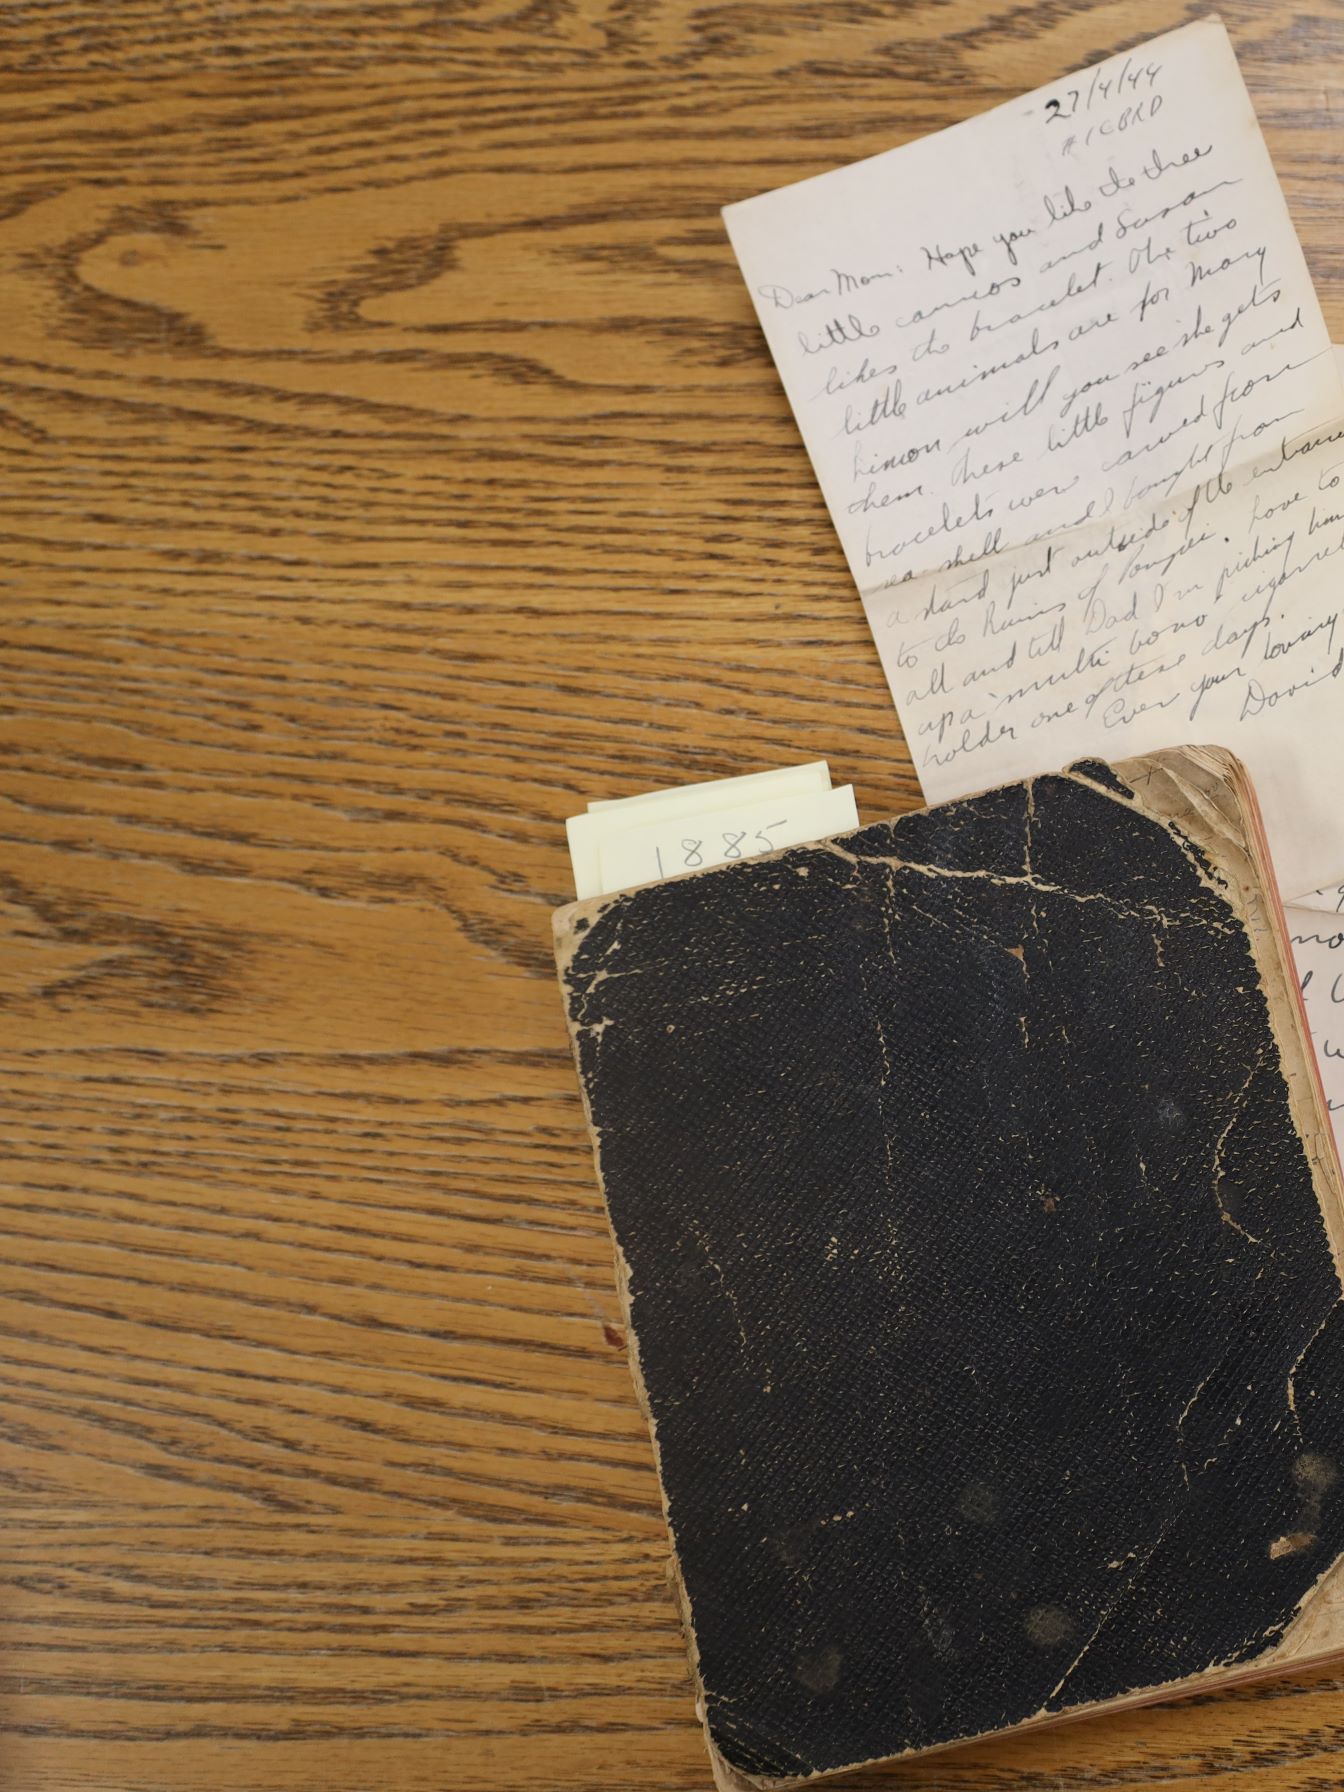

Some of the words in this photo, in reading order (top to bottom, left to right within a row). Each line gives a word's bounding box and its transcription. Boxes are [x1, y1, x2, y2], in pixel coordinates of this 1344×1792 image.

[758, 284, 830, 310] Dear
[920, 242, 984, 277] Hope
[993, 228, 1036, 266] you
[1043, 185, 1092, 225] like
[1099, 167, 1136, 197] the
[1143, 144, 1213, 180] three
[797, 314, 880, 355] little
[1040, 222, 1104, 273] and
[1116, 178, 1243, 239] Susan
[817, 358, 897, 398] likes
[912, 329, 950, 362] the
[1185, 209, 1238, 246] two
[840, 379, 907, 436] little
[916, 327, 1059, 406] animals
[1068, 312, 1119, 342] are
[1133, 280, 1170, 322] for
[955, 364, 1061, 446] will
[1060, 373, 1120, 418] you
[1124, 344, 1169, 372] see
[1174, 304, 1214, 349] she
[1218, 277, 1282, 348] gets
[1047, 402, 1108, 452] little
[1122, 359, 1225, 439] figures
[1241, 307, 1304, 355] and
[866, 492, 999, 567] bracelets
[1025, 500, 1095, 546] and
[1124, 437, 1228, 510] bought
[1219, 409, 1304, 474] from
[887, 605, 909, 628] a
[915, 568, 990, 621] stand
[1008, 546, 1063, 608] just
[1071, 512, 1170, 568] outside
[897, 639, 928, 669] to
[982, 600, 1067, 637] Ruins
[1077, 562, 1110, 622] of
[1317, 461, 1344, 491] to
[906, 662, 953, 705] all
[962, 641, 1017, 688] and
[1028, 615, 1066, 660] tell
[1085, 591, 1138, 636] Dad
[1214, 531, 1295, 604] picking
[918, 710, 955, 744] up
[922, 720, 1018, 768] holder
[1031, 700, 1079, 728] one
[1103, 692, 1181, 729] Ever
[1189, 666, 1246, 722] your
[1263, 612, 1338, 660] loving
[655, 819, 788, 880] 1885
